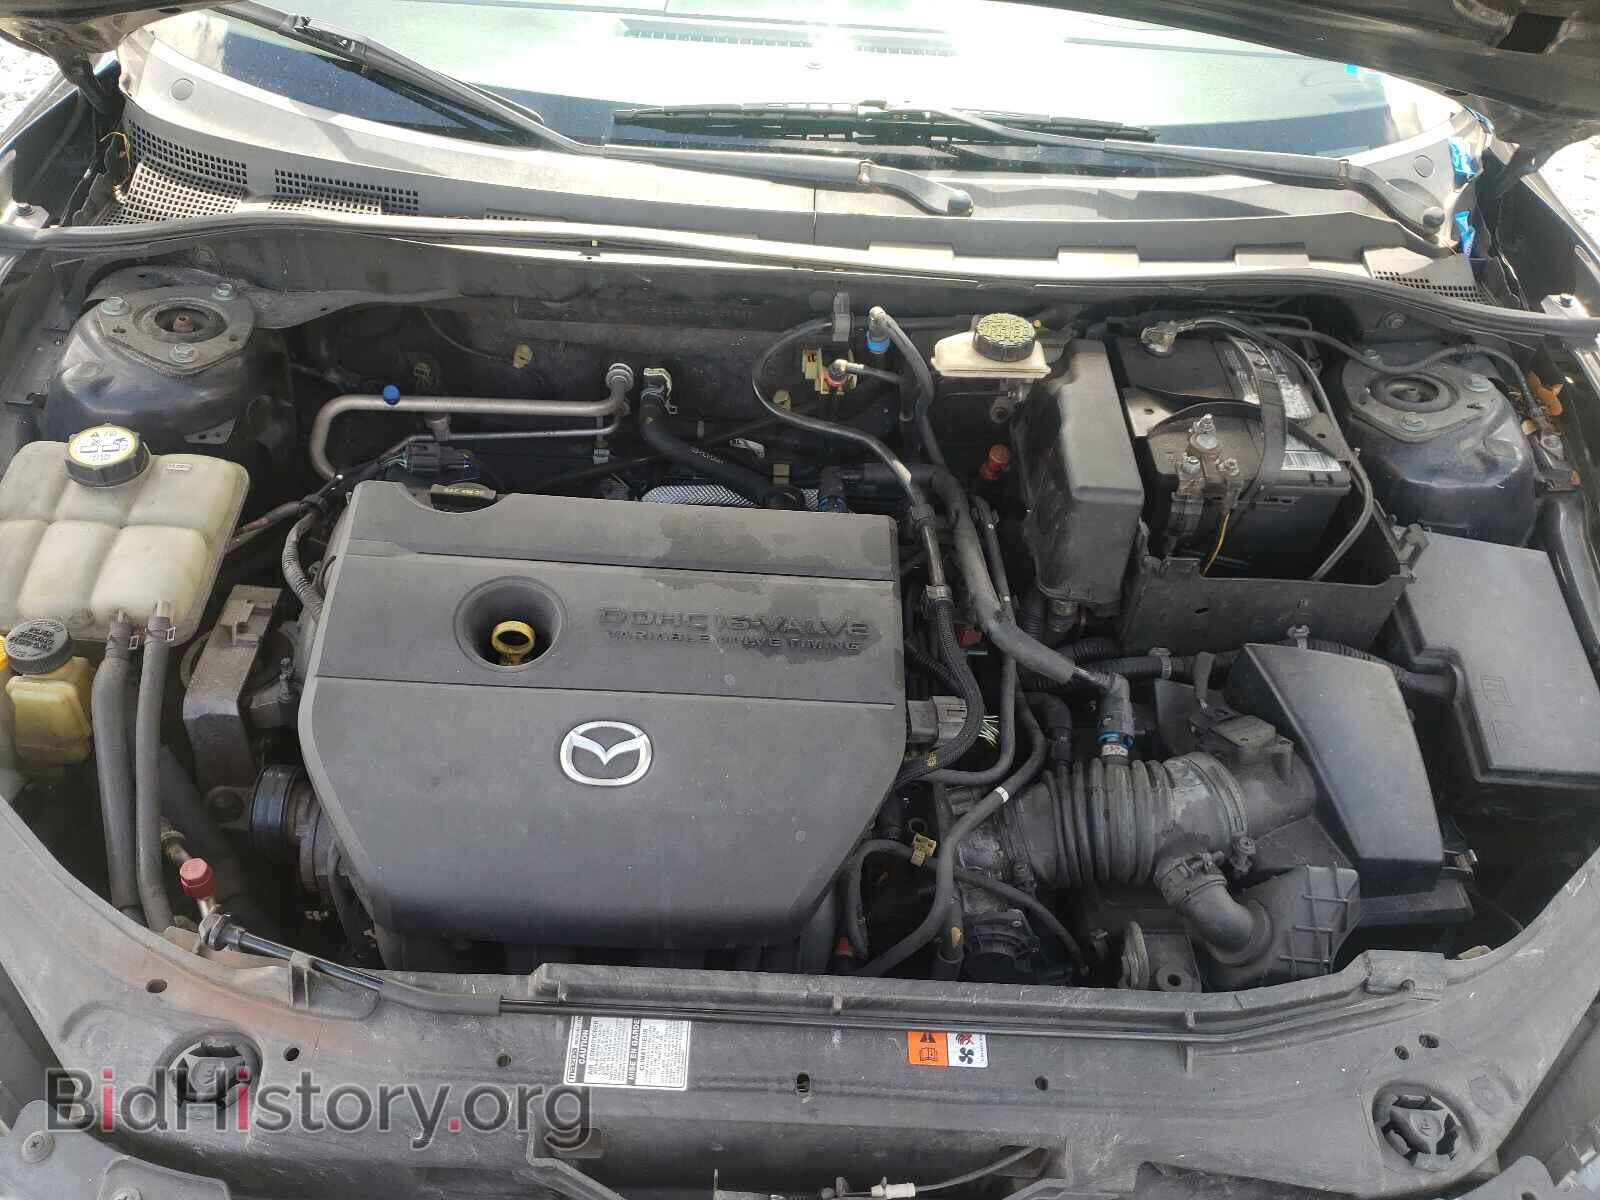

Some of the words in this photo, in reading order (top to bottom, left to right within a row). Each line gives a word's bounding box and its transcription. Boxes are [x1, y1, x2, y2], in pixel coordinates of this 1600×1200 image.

[599, 609, 708, 631] DOHC
[788, 638, 859, 652] TIMING
[578, 1029, 589, 1065] CAUTION
